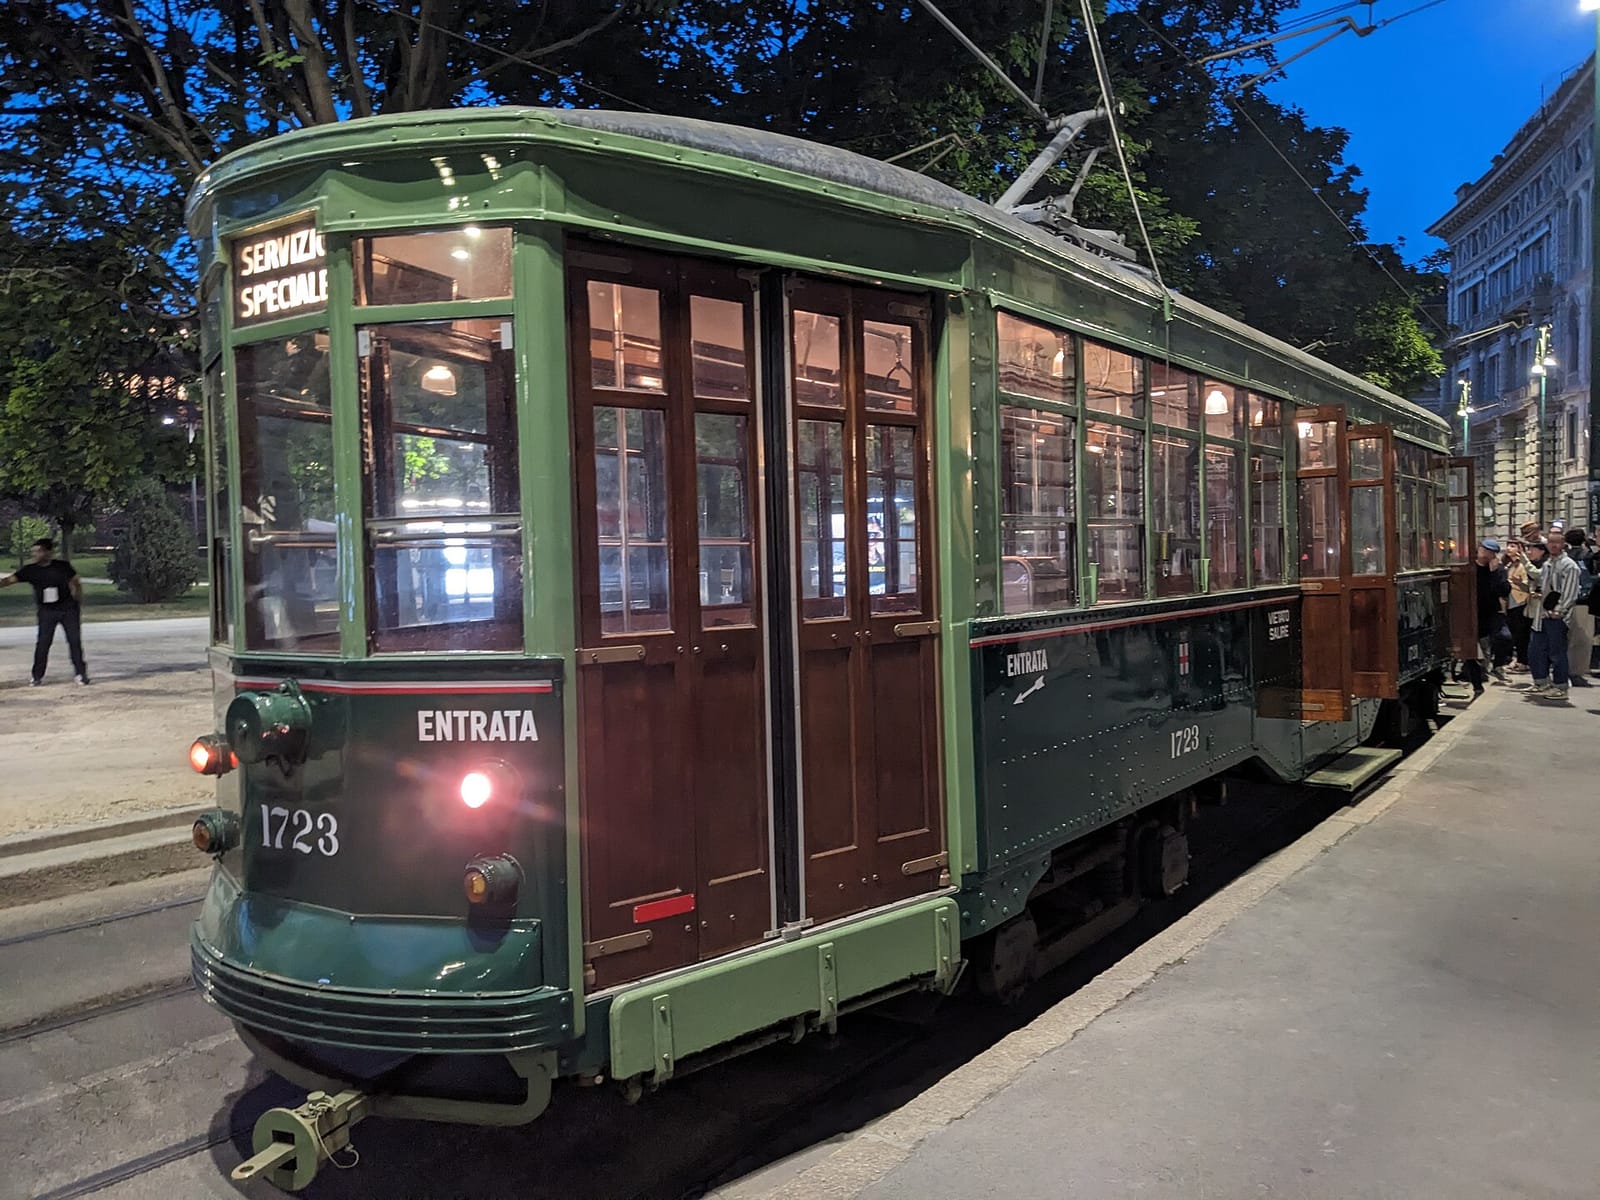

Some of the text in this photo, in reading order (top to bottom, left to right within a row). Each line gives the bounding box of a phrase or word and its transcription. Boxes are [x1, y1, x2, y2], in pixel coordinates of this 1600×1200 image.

[240, 269, 328, 318] SPECIALE
[1268, 609, 1289, 624] VIETATO
[1269, 625, 1289, 640] SALIRE
[1007, 649, 1048, 677] ENTRATA
[418, 710, 538, 742] ENTRATA
[1171, 725, 1199, 759] 1723
[260, 804, 340, 856] 1723
